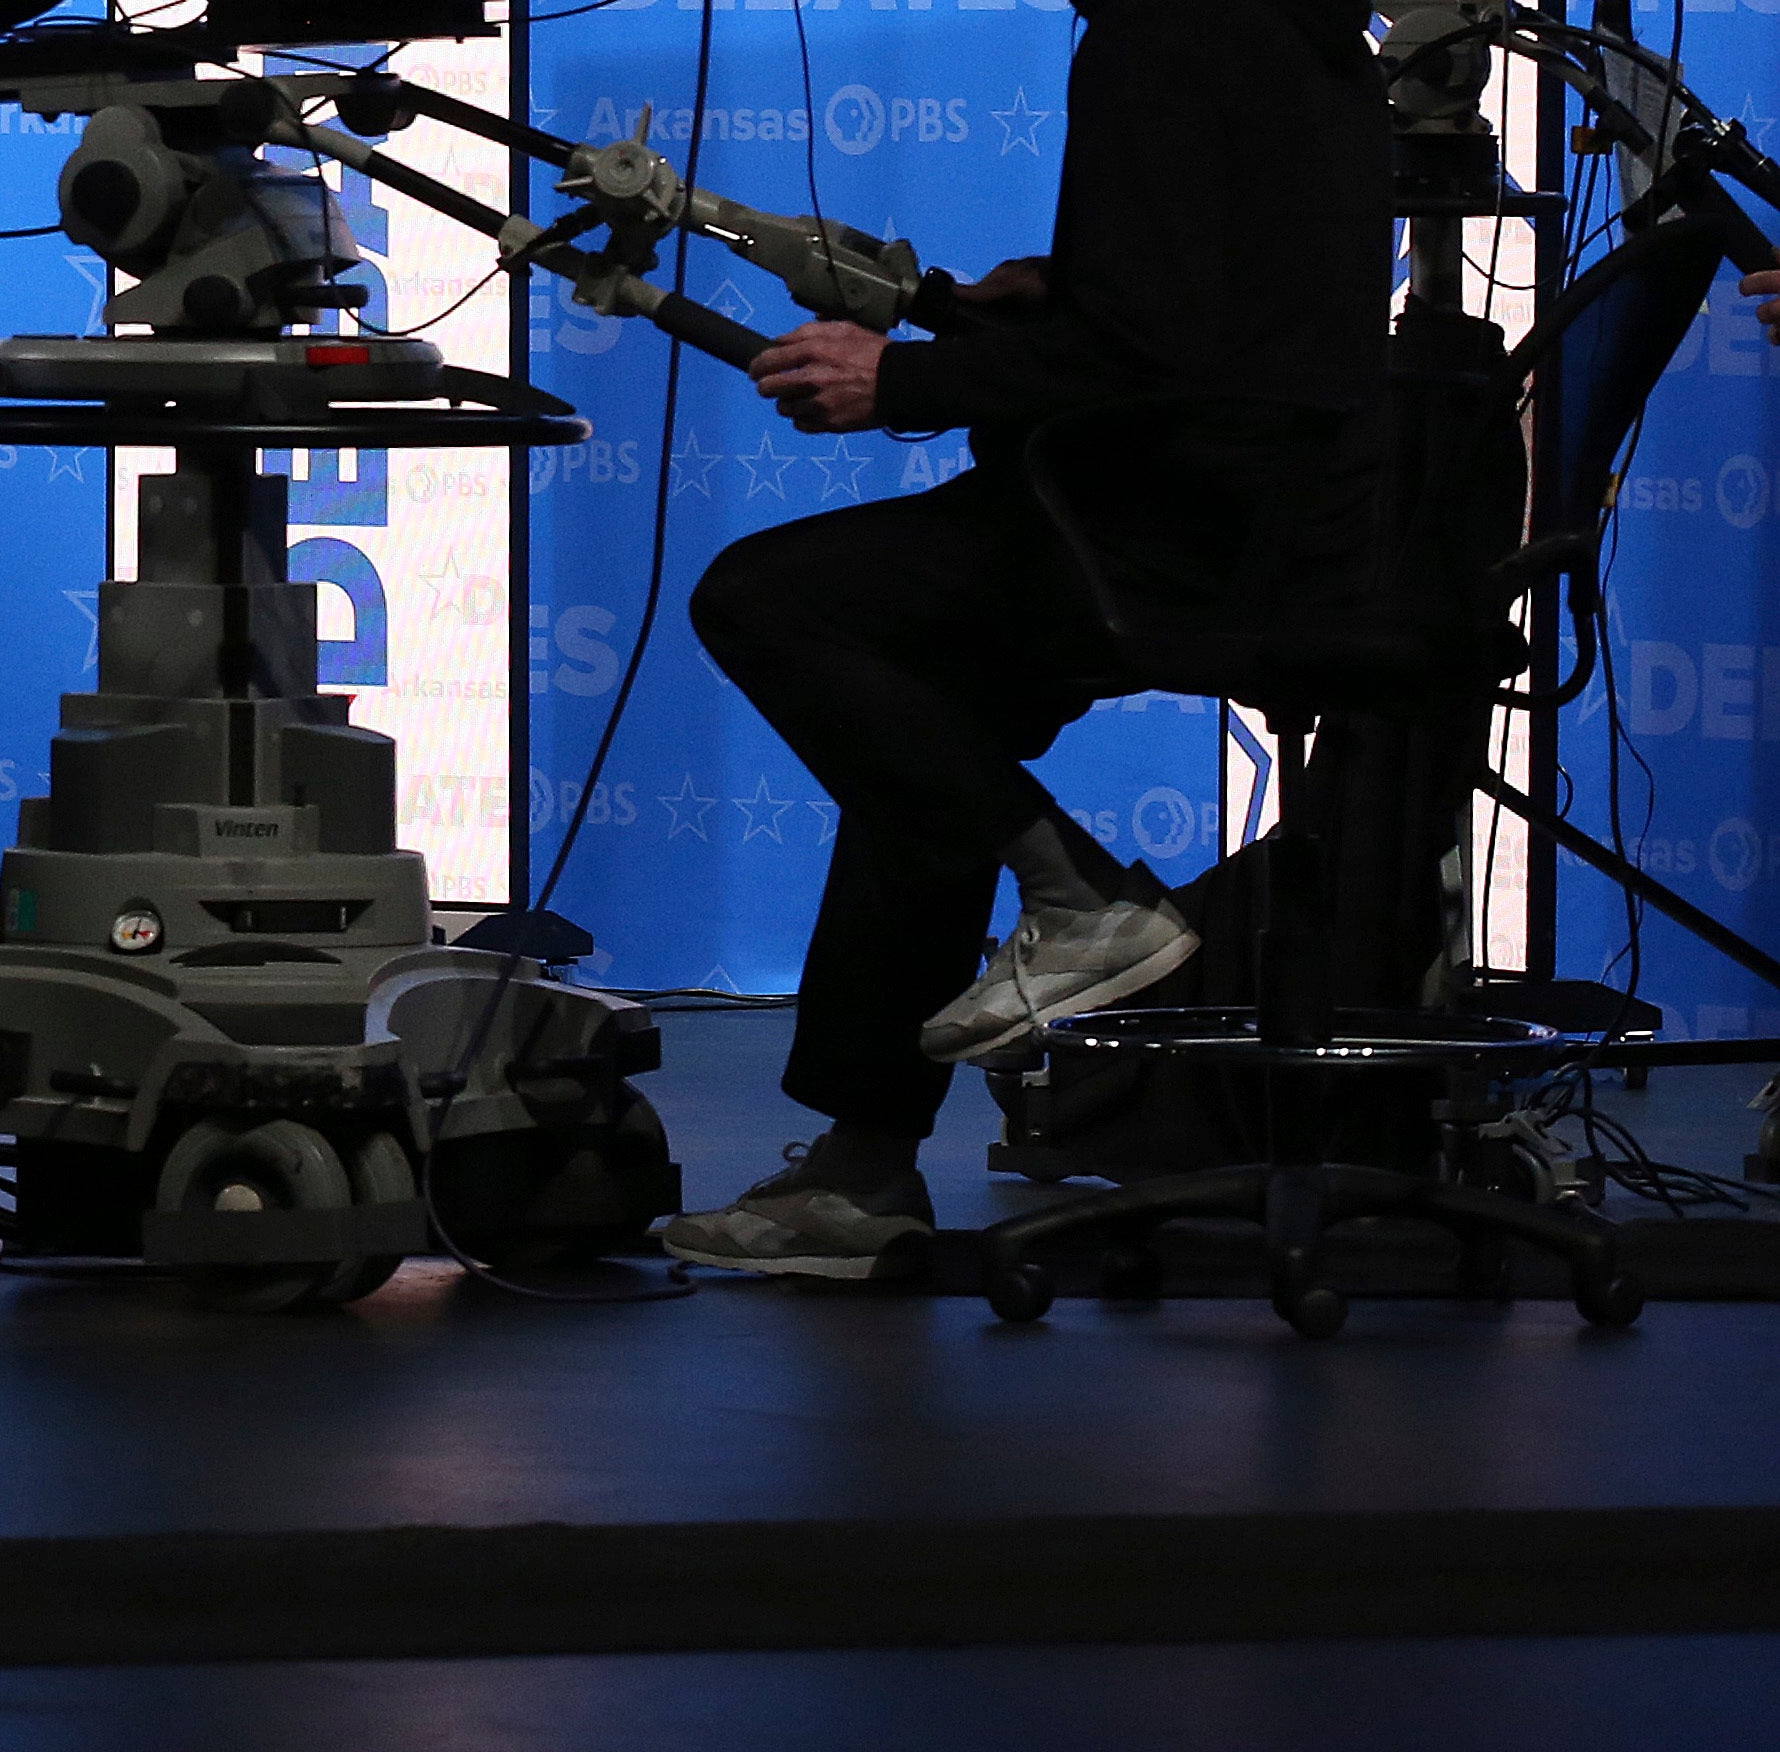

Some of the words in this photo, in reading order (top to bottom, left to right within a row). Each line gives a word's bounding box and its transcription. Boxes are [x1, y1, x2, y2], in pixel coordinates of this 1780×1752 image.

[444, 71, 487, 96] PBS
[585, 96, 810, 143] Arkansas
[890, 96, 969, 143] PBS
[557, 439, 638, 484] PBS
[443, 471, 487, 498] PBS
[560, 783, 636, 827] PBS
[213, 818, 280, 839] Vinten
